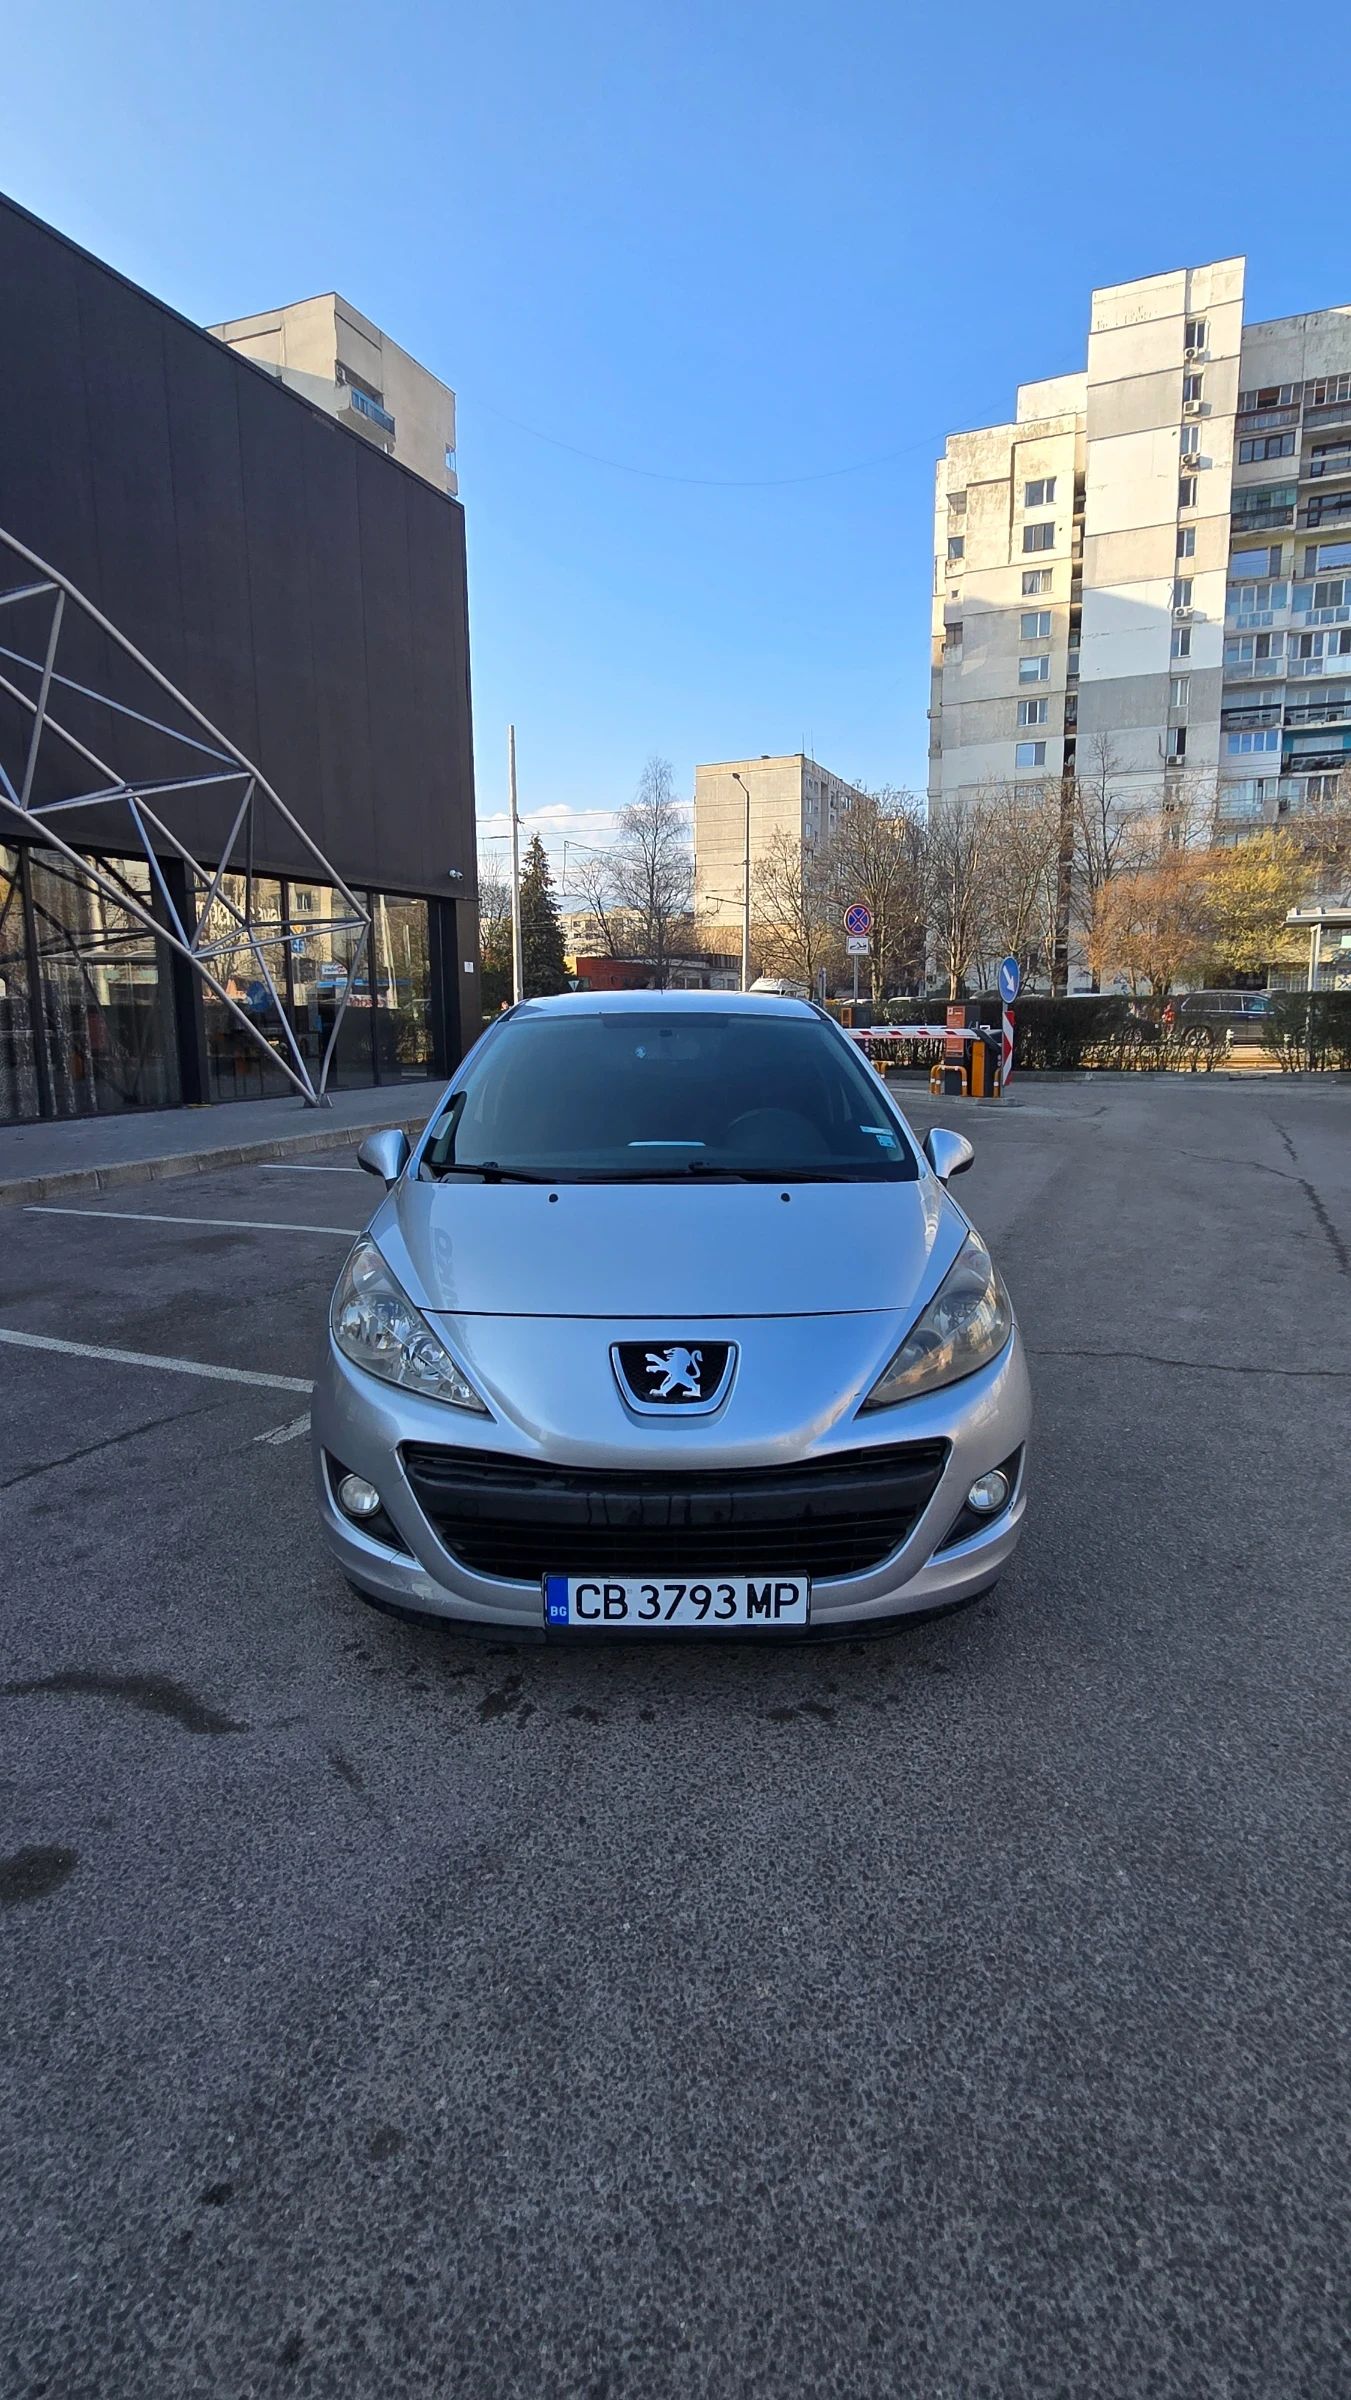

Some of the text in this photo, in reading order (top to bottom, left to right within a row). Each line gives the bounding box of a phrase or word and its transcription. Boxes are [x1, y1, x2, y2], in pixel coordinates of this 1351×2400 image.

[550, 1605, 567, 1617] BG
[576, 1582, 800, 1620] CB 3793 MP
